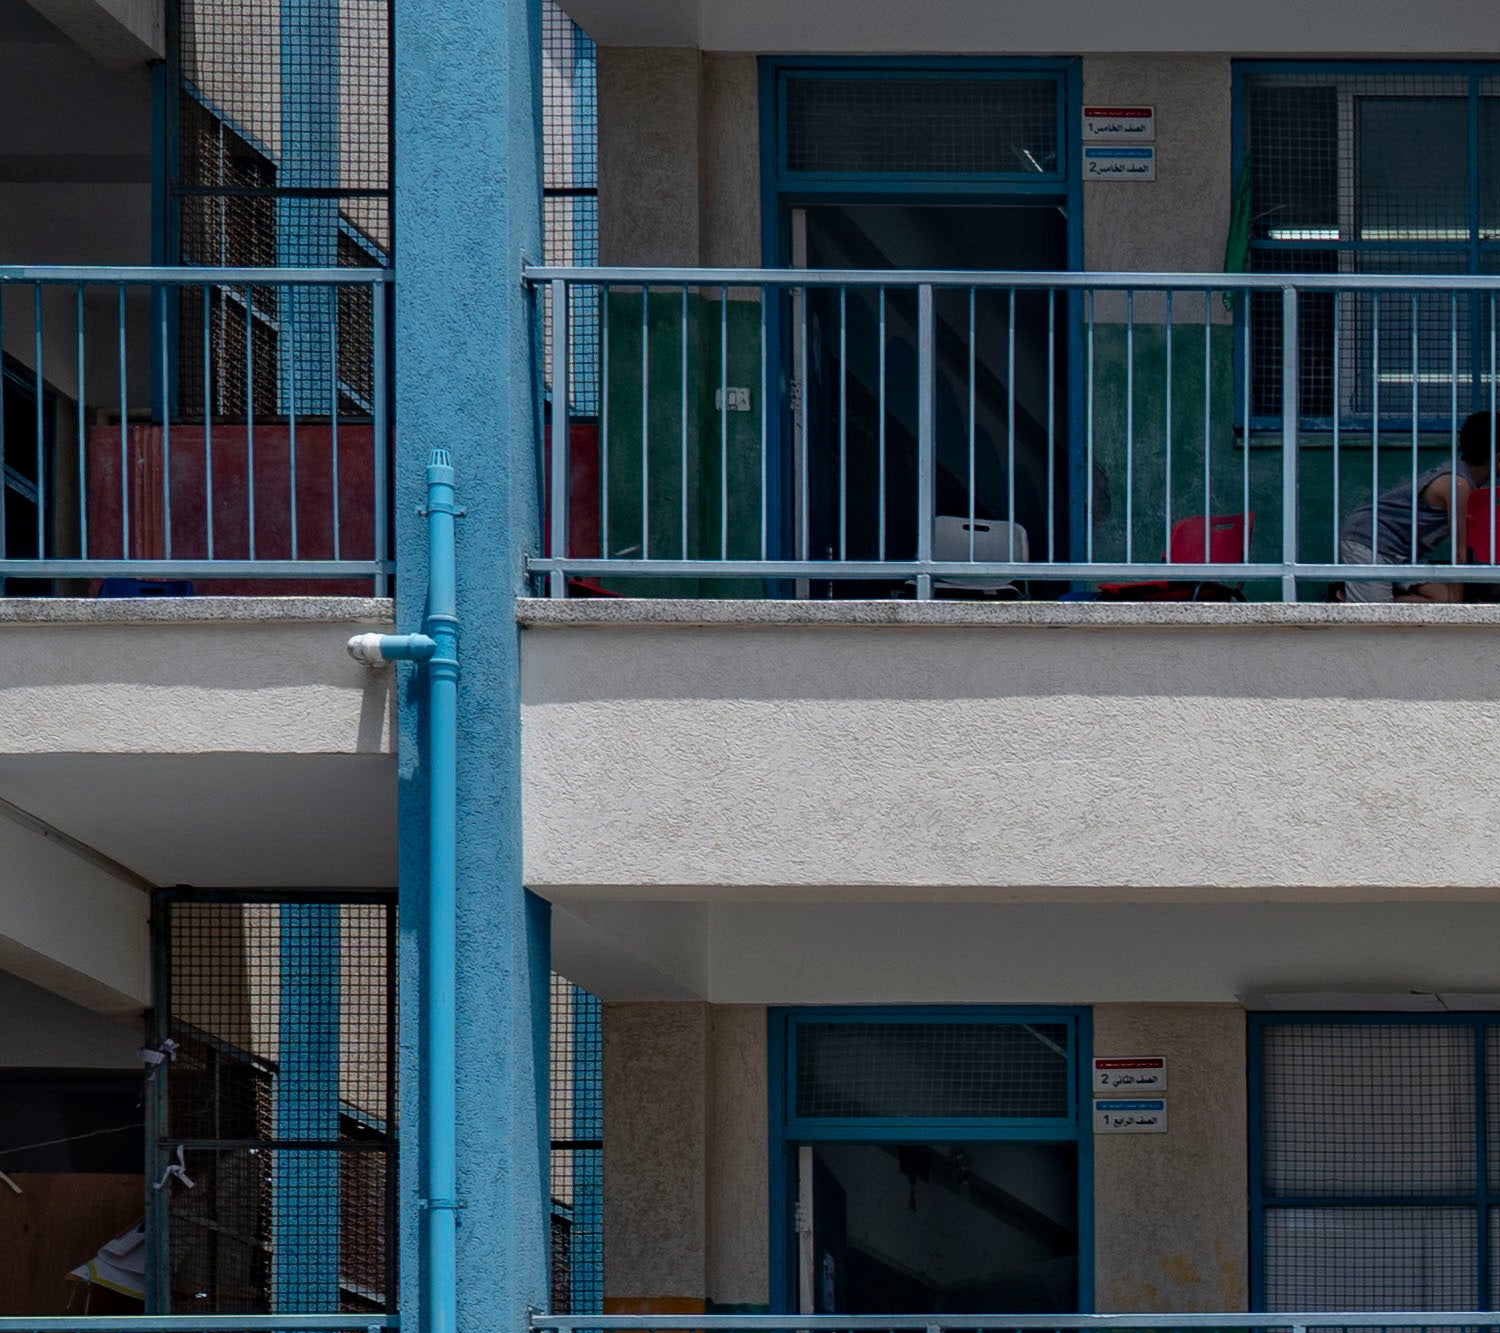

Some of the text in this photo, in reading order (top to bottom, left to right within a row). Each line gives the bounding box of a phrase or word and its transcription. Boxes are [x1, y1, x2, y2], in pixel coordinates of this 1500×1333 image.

[1088, 123, 1094, 131] 1
[1123, 123, 1145, 133] الصف
[1089, 162, 1096, 171] 2
[1126, 162, 1148, 173] الصف
[1101, 1074, 1108, 1084] 2
[1135, 1074, 1157, 1086] الصف
[1103, 1116, 1109, 1126] 1
[1135, 1116, 1157, 1128] الصف
